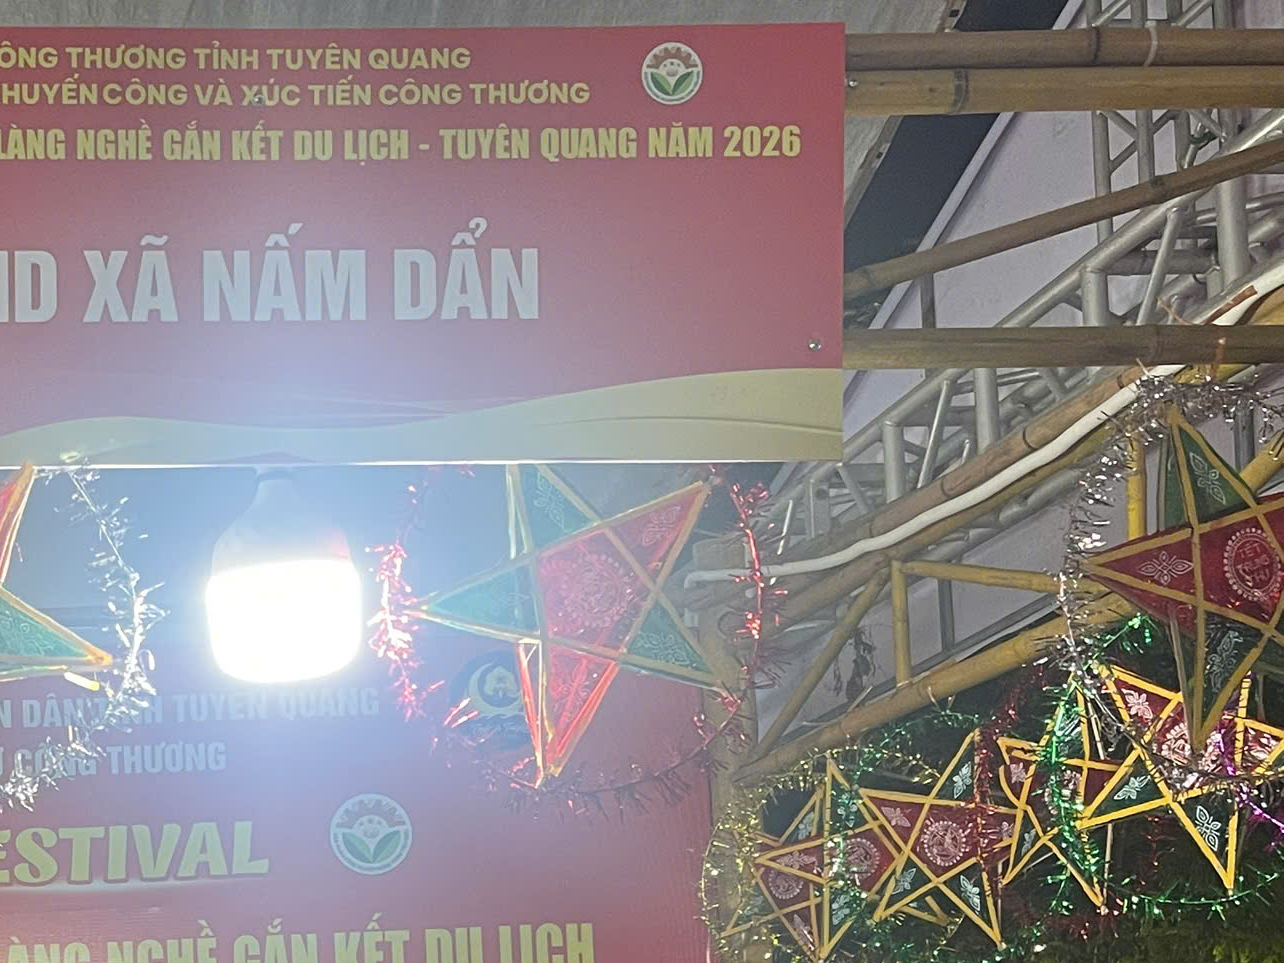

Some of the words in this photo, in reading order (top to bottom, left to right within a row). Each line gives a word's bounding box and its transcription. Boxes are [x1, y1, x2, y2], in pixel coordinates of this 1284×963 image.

[67, 44, 187, 69] THƯƠNG
[194, 40, 259, 70] TỈNH
[267, 43, 361, 70] TUYÊN
[369, 48, 471, 70] QUANG
[103, 77, 188, 105] CÔNG
[194, 79, 233, 106] VÀ
[241, 77, 300, 106] XÚC
[308, 75, 371, 106] TIẾN
[380, 79, 461, 106] CÔNG
[469, 80, 590, 105] THƯƠNG
[77, 119, 152, 160] NGHỀ
[164, 122, 220, 161] GẮN
[232, 120, 283, 162] KẾT
[295, 130, 332, 161] DU
[343, 129, 408, 166] LỊCH
[440, 123, 529, 159] TUYÊN
[540, 127, 637, 162] QUANG
[648, 122, 713, 158] NĂM
[724, 125, 801, 157] 2026
[83, 235, 178, 324] XÃ
[203, 223, 366, 322] NẤM
[393, 217, 539, 320] DẨN
[22, 694, 90, 729] DÂN
[107, 740, 227, 774] THƯƠNG
